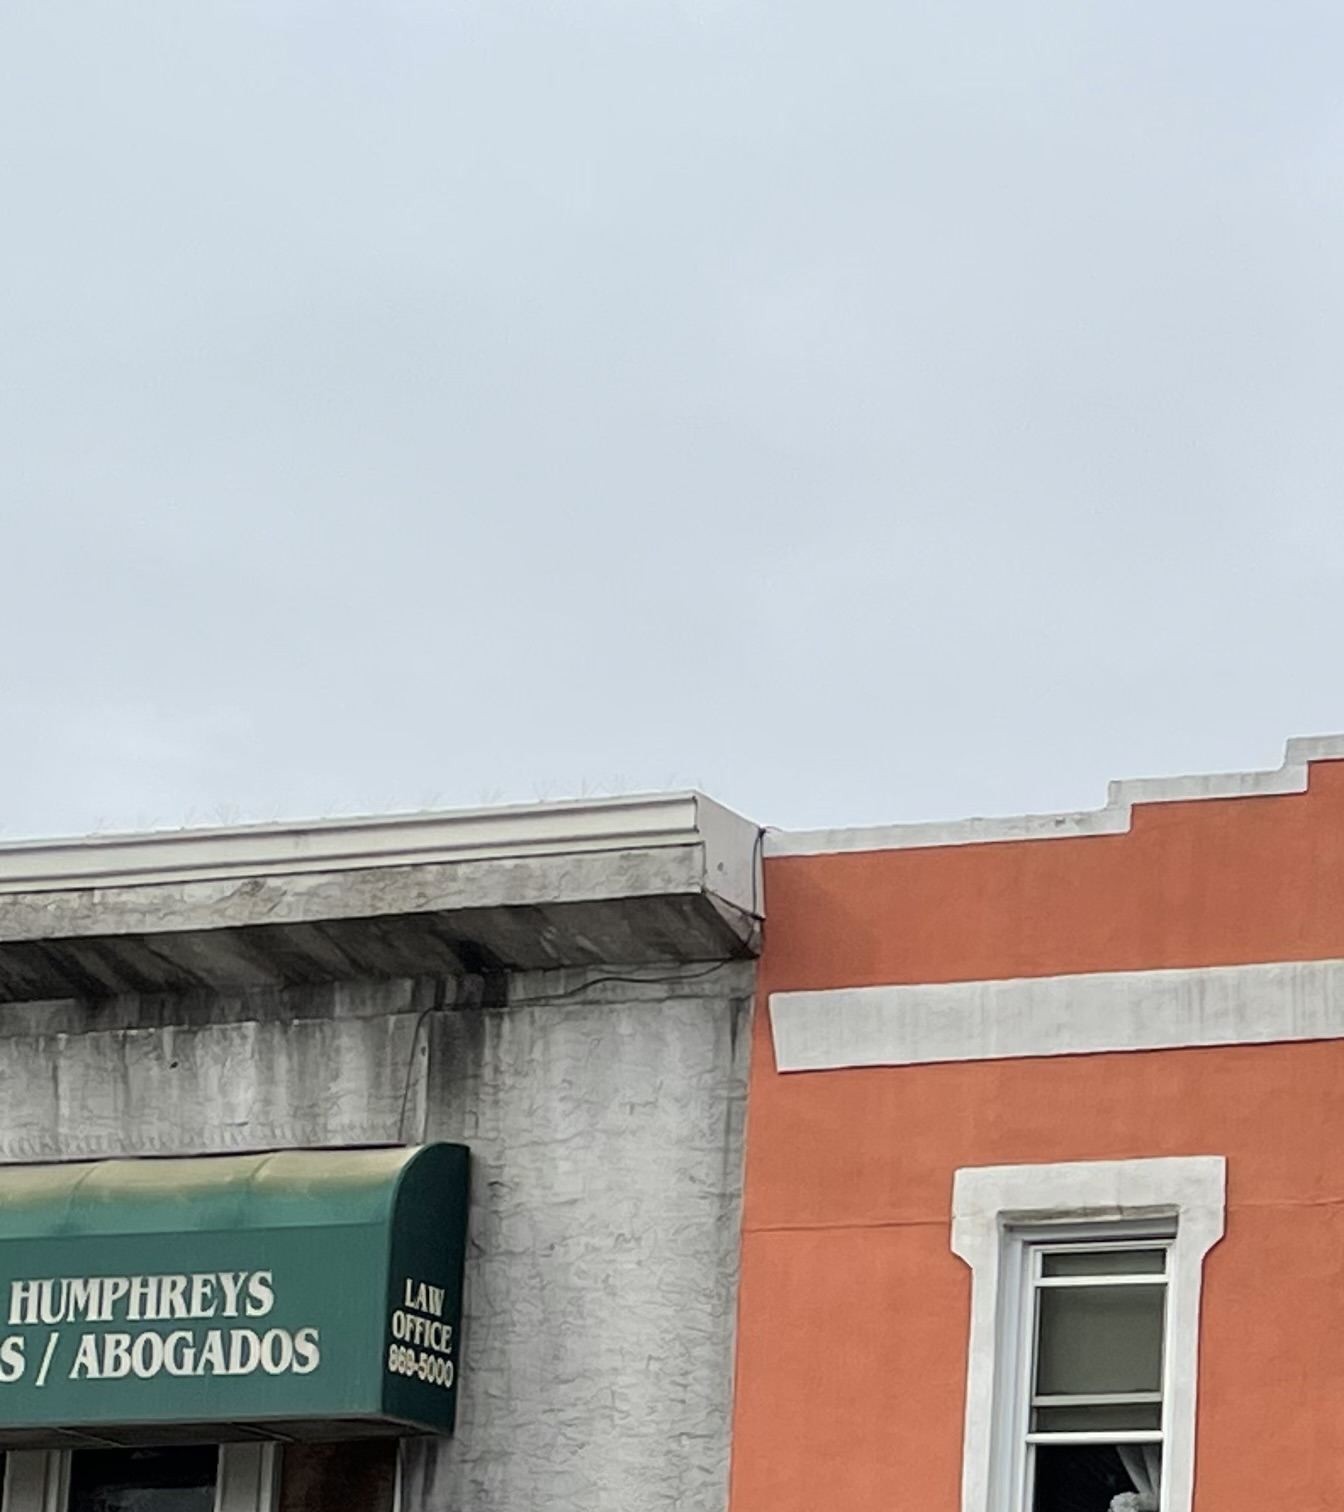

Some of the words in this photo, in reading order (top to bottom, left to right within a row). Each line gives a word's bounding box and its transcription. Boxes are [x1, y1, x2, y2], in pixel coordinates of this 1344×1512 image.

[8, 1270, 274, 1325] HUMPHREYS
[405, 1278, 445, 1316] LAW
[69, 1328, 320, 1379] ABOGADOS
[392, 1310, 452, 1354] OFFICE
